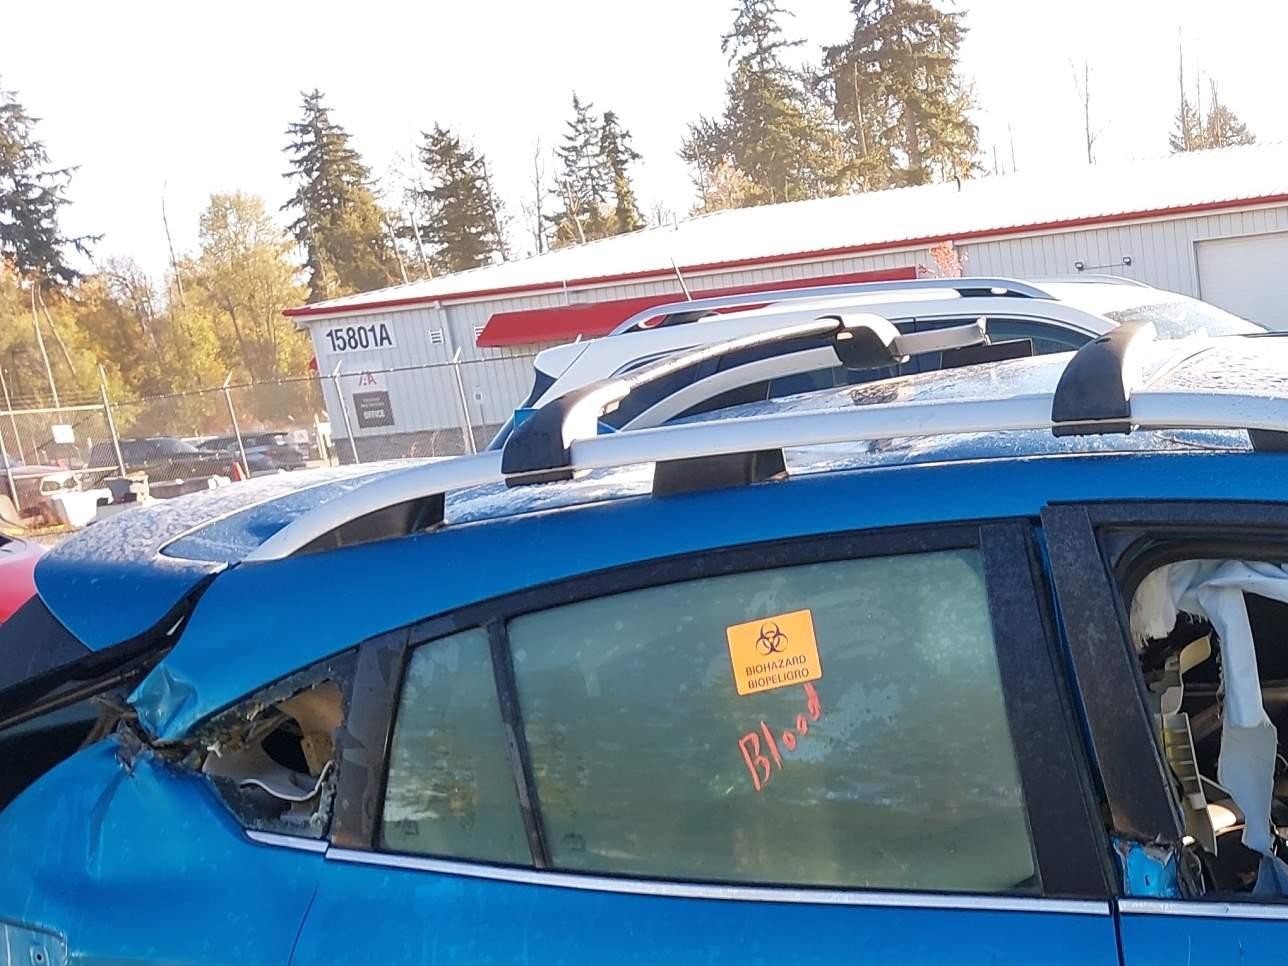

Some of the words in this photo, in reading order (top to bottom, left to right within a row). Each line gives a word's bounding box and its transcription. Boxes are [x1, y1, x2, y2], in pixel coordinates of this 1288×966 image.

[326, 323, 393, 352] 15801A
[745, 654, 807, 677] BIOHAZARD
[747, 667, 810, 689] BIOPELIGRO
[738, 681, 821, 792] Blood
